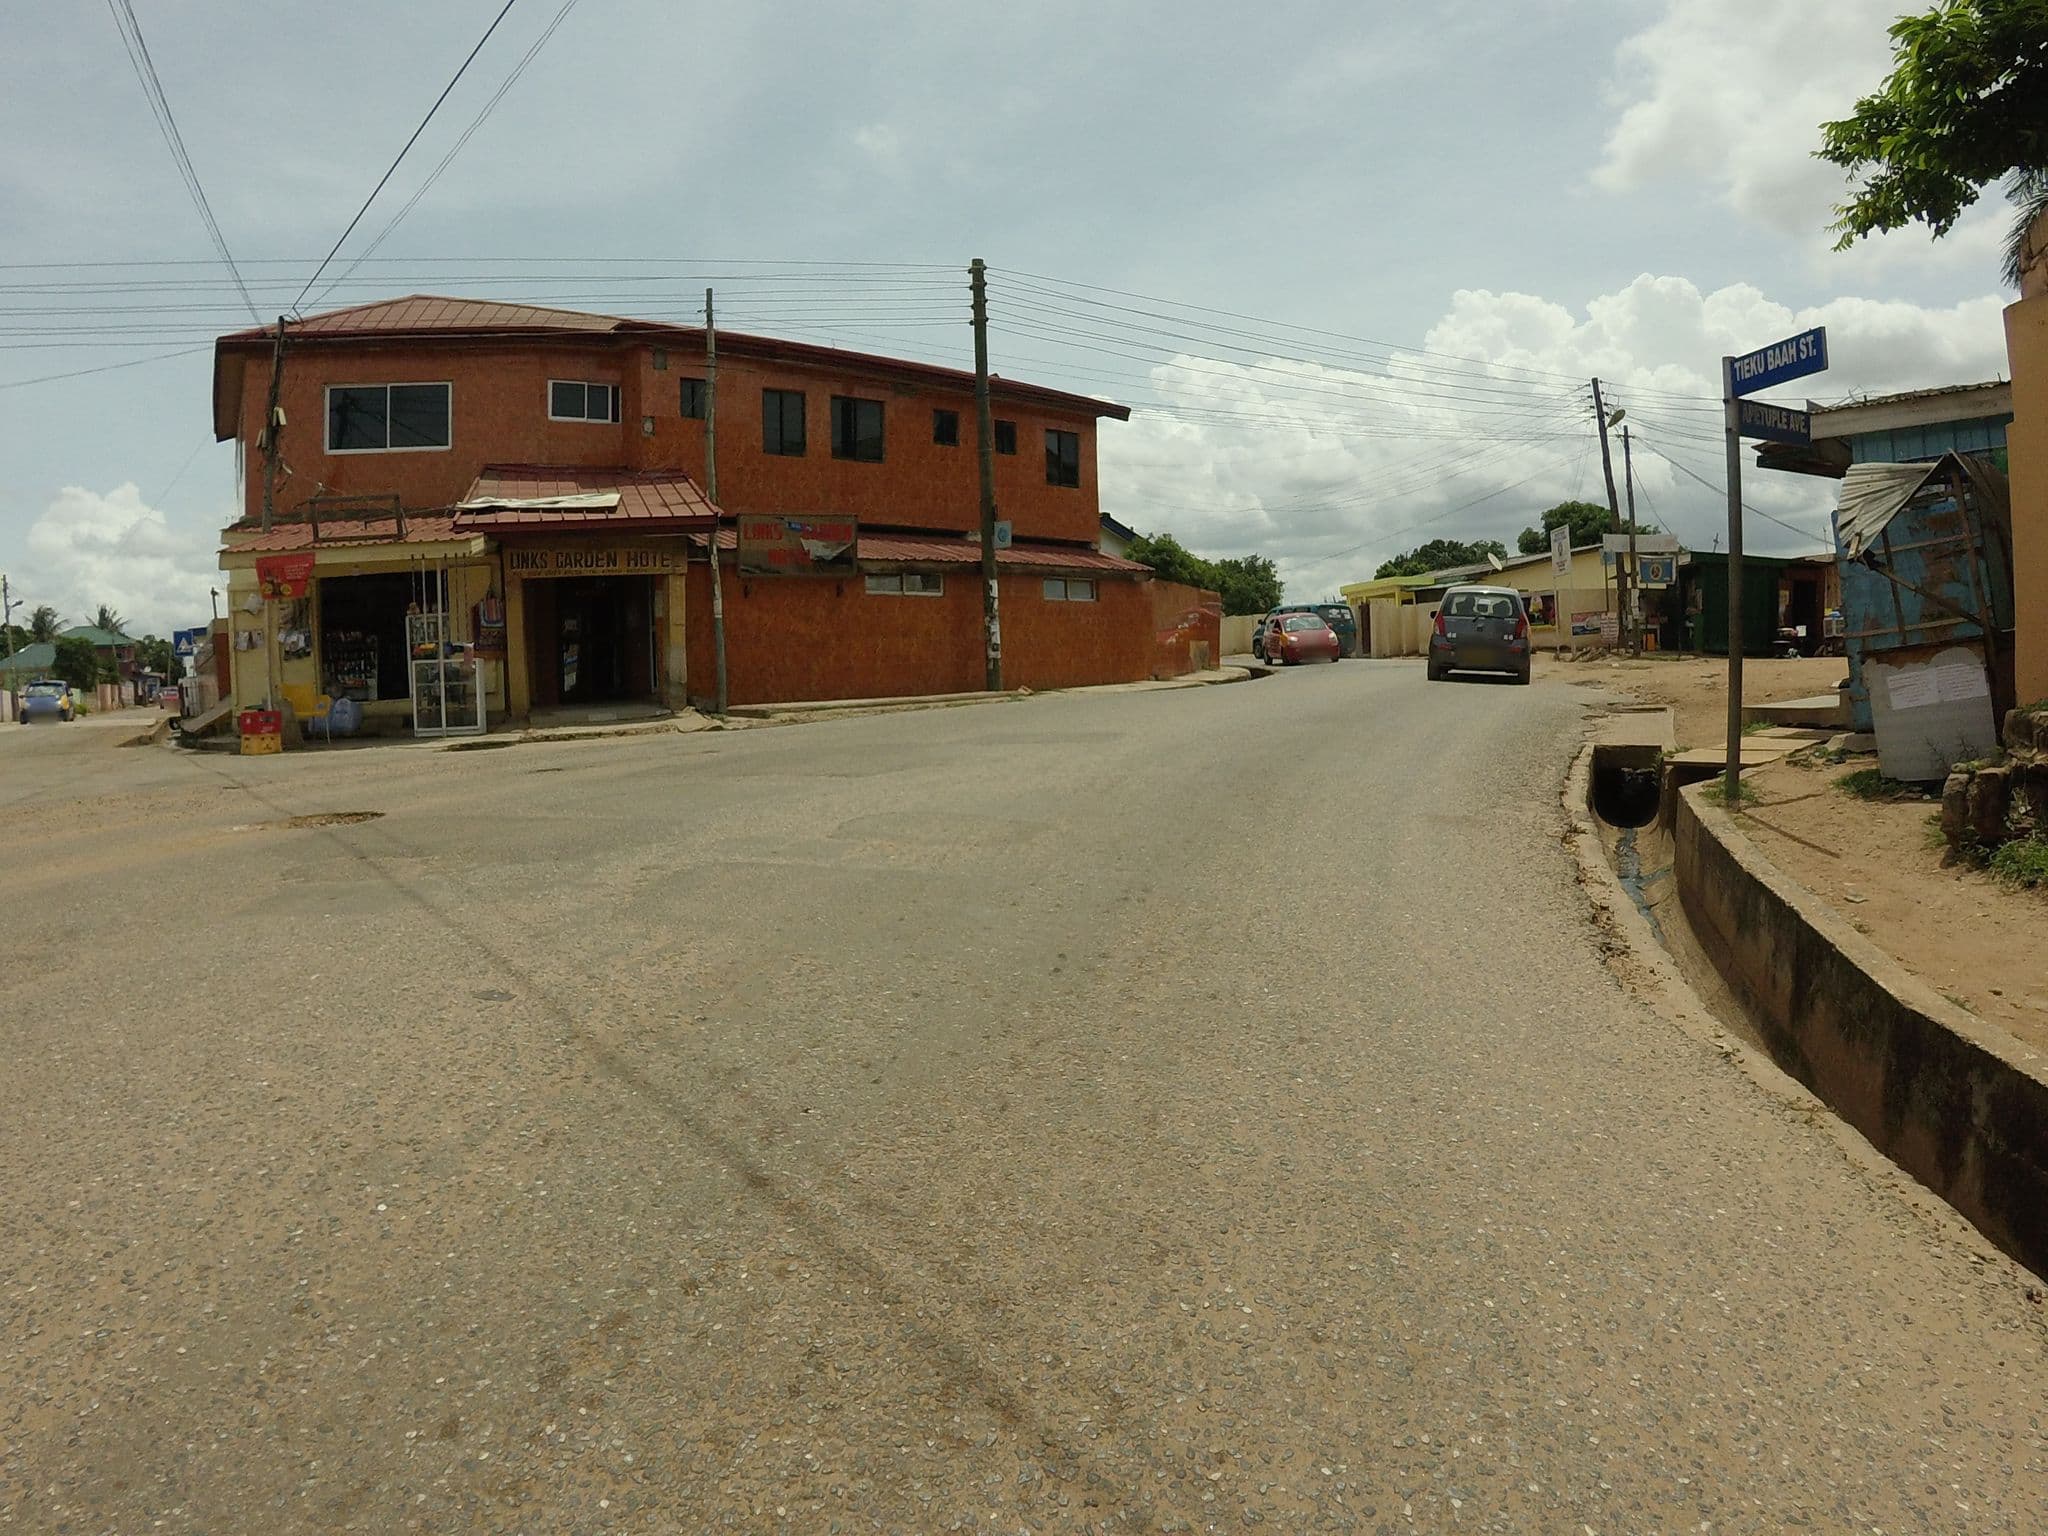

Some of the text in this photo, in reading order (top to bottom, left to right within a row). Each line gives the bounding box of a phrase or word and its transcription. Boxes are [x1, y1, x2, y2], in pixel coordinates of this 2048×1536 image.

[1734, 335, 1817, 382] TIEKU BAAH ST.
[510, 551, 548, 570] LINKS
[555, 551, 617, 569] GARDEN
